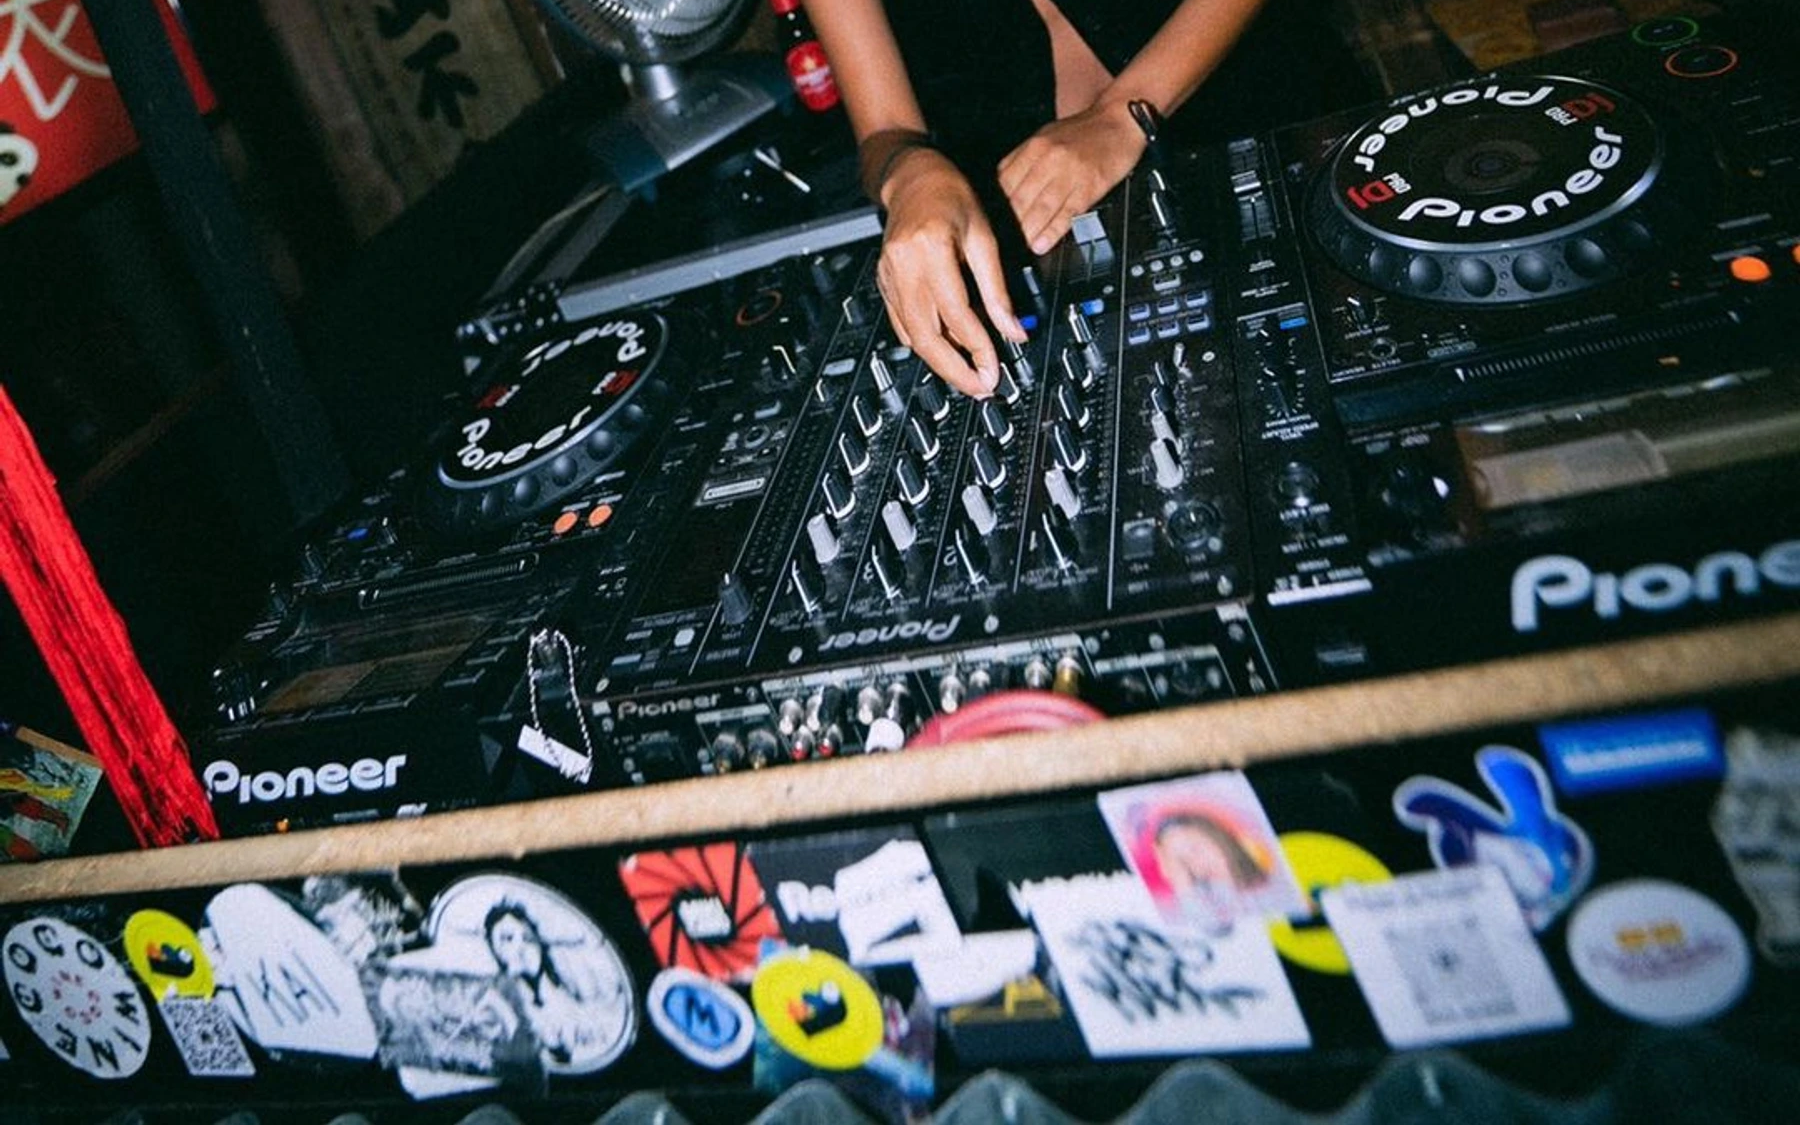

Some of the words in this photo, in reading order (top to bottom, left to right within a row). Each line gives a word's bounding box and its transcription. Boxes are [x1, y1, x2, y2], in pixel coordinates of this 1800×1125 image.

[1355, 85, 1554, 172] Pioneer
[1398, 126, 1623, 227] Pioneer
[819, 614, 962, 652] Pioneer
[617, 693, 722, 721] Pioneer
[203, 753, 408, 805] Pioneer
